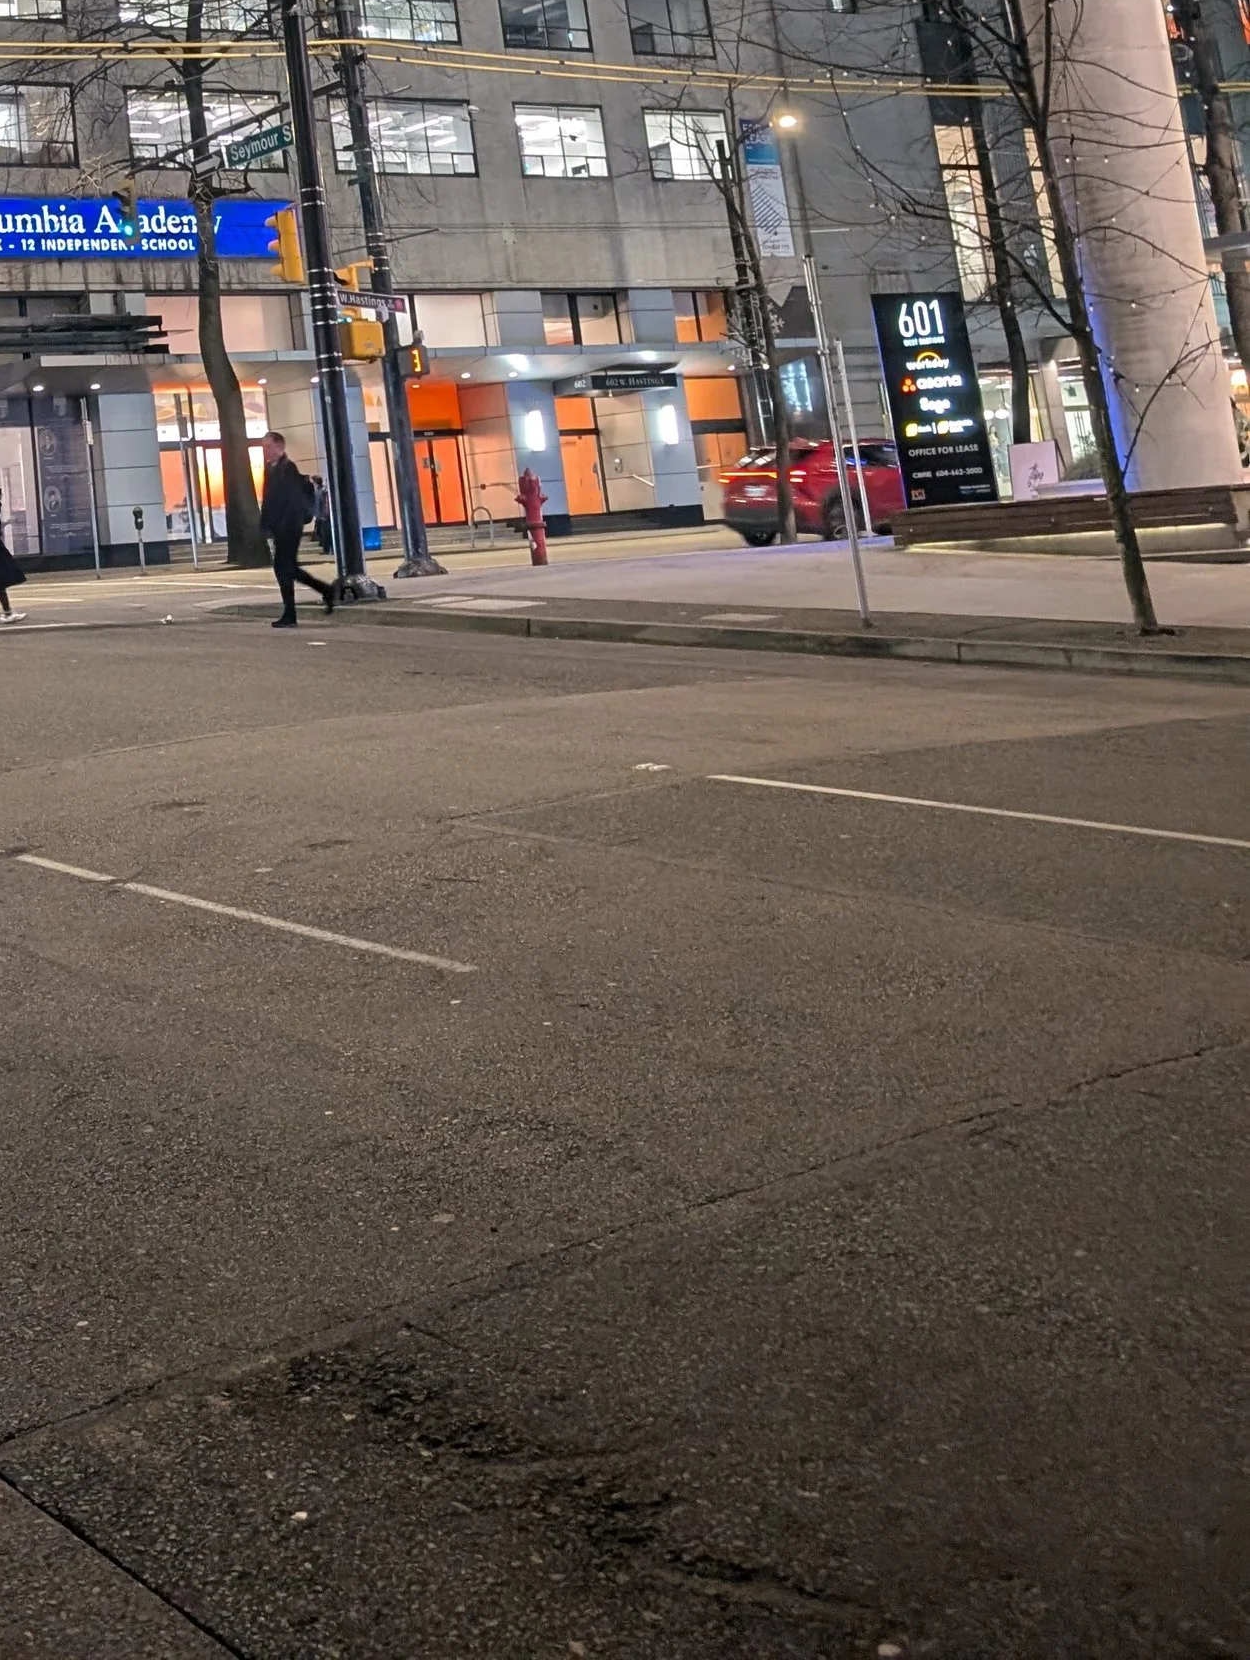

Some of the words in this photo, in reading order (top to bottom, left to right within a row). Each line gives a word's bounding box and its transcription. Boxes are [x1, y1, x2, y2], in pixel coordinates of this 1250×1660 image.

[231, 133, 279, 161] Seymour
[282, 125, 293, 142] S
[93, 204, 222, 235] Aadem
[21, 238, 35, 251] 12
[41, 238, 135, 251] INDEPENDEN
[141, 238, 196, 251] SCHOOL
[898, 300, 943, 337] 601
[574, 379, 586, 388] 602
[916, 374, 962, 390] asana
[908, 447, 937, 457] OFFICE
[937, 446, 954, 455] FOR
[955, 444, 979, 453] LEASE
